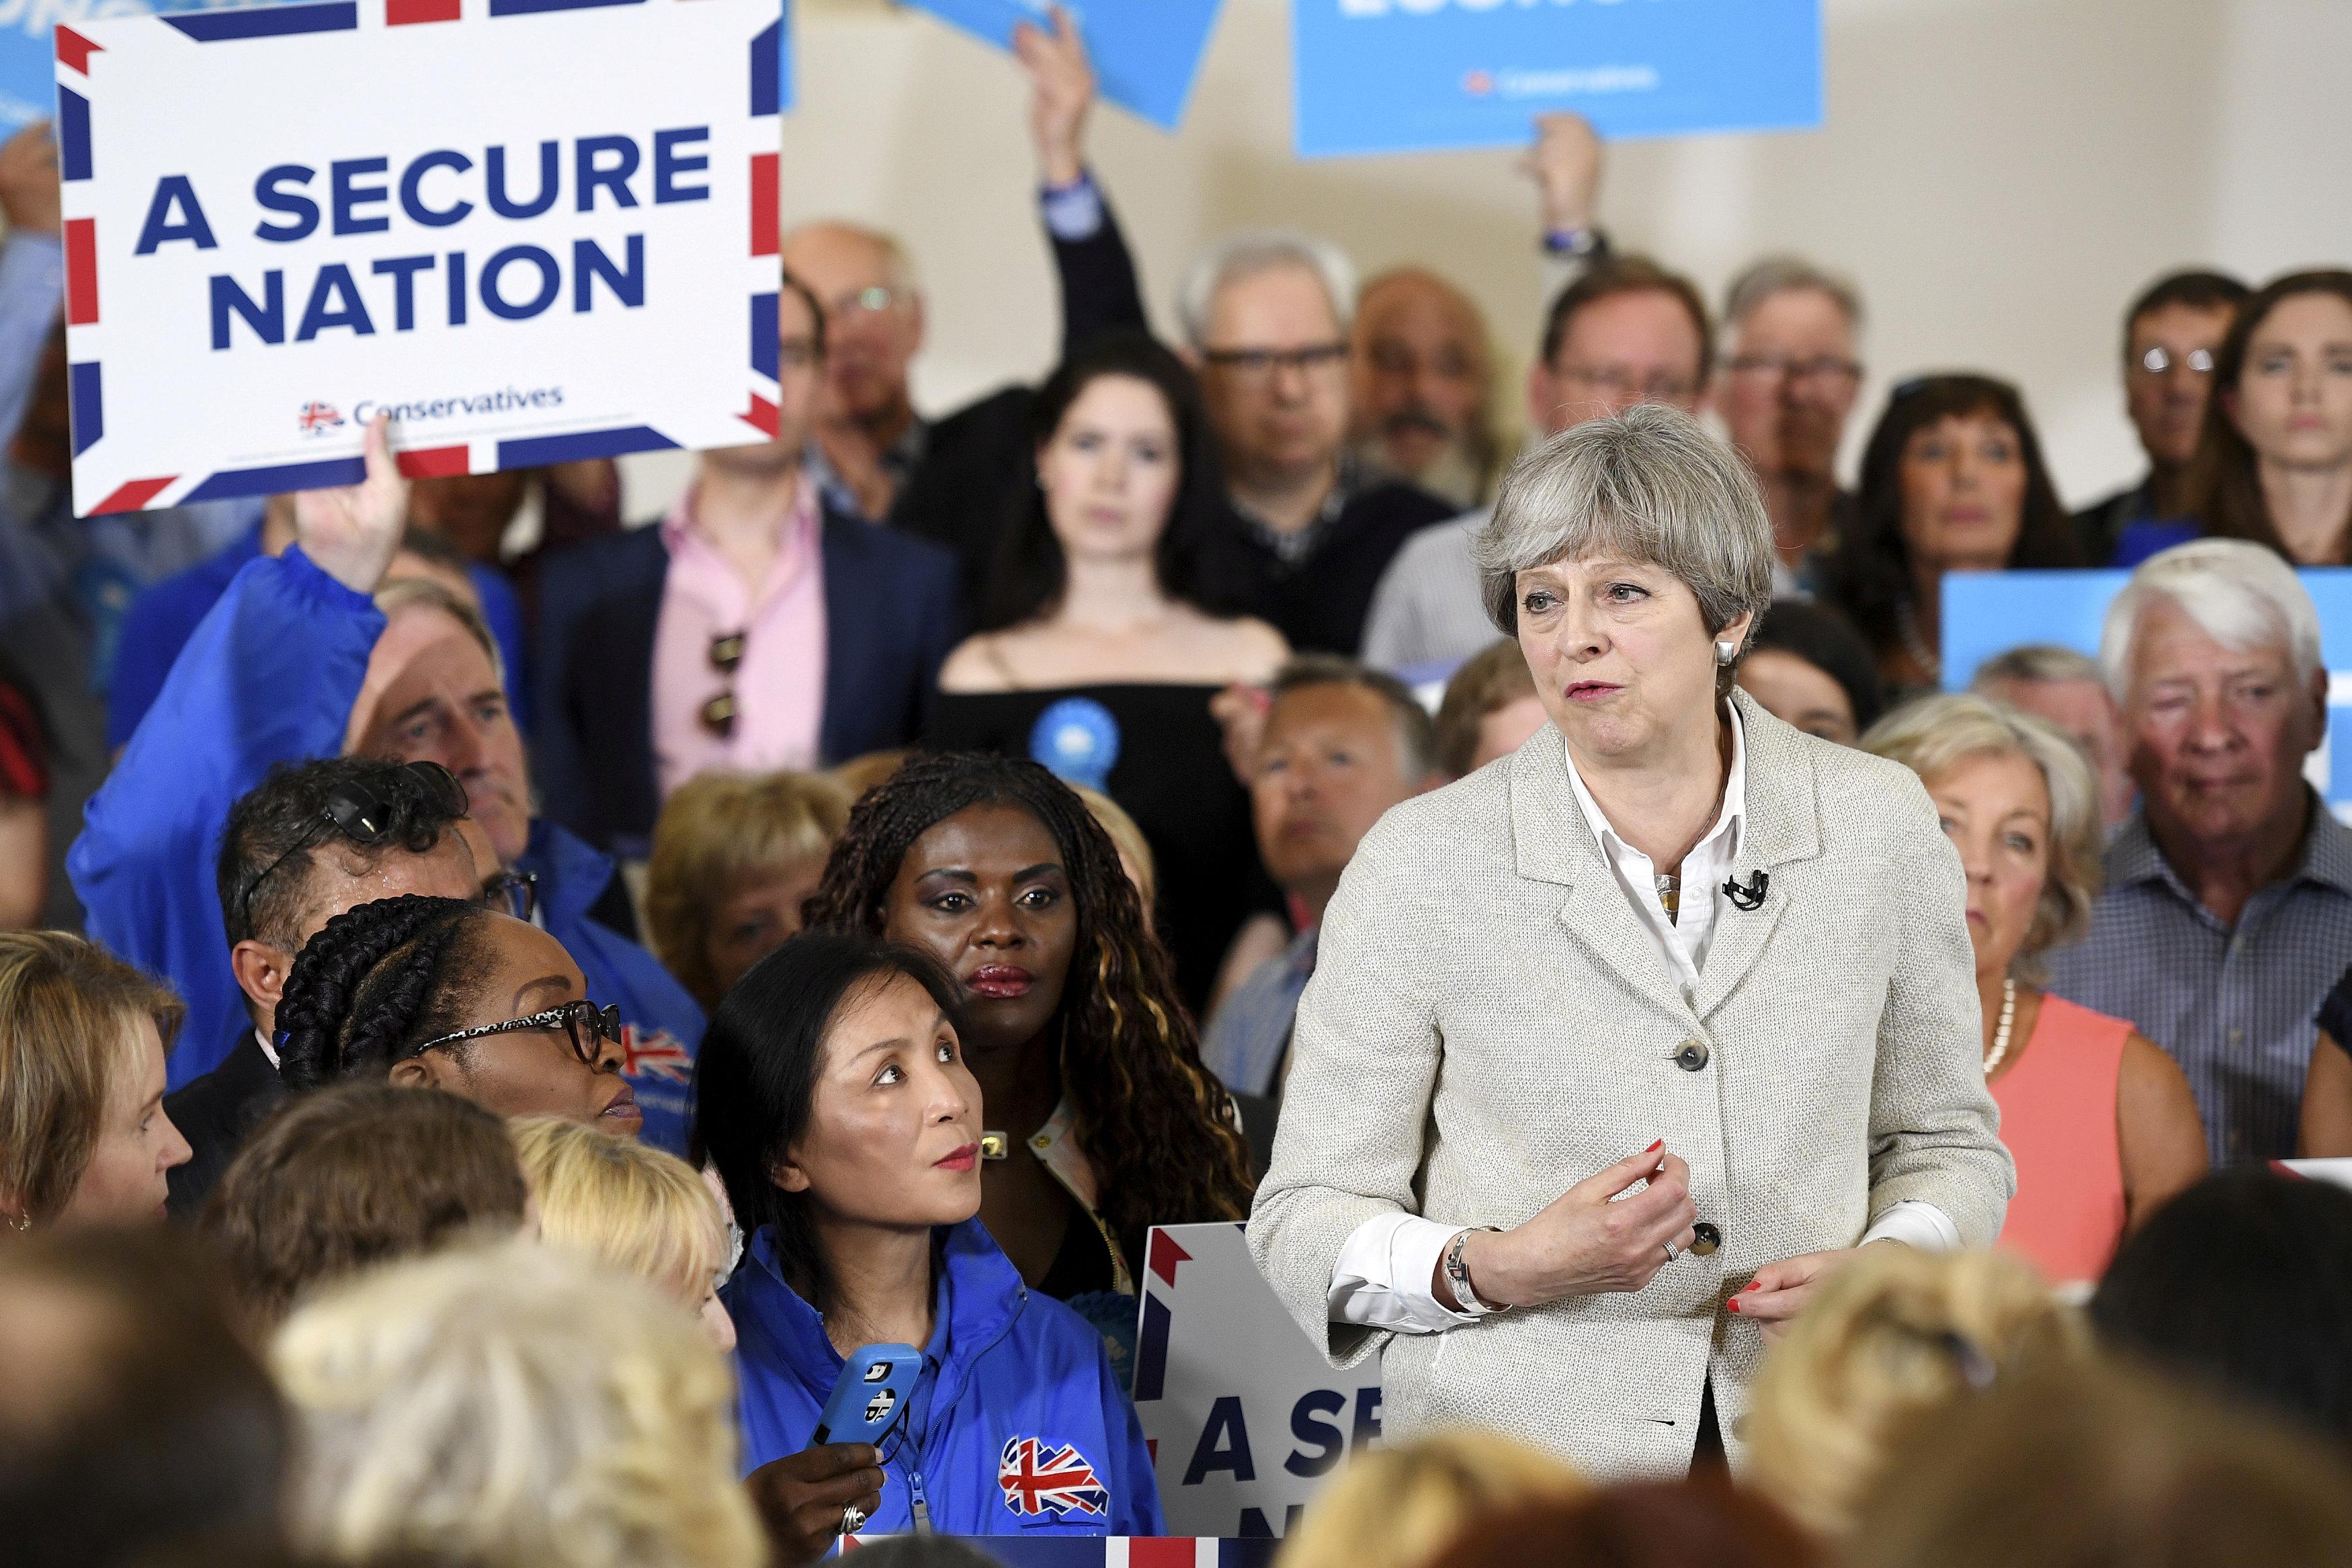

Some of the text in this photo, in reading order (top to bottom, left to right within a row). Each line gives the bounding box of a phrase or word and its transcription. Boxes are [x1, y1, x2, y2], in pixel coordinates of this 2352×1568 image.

[134, 125, 710, 256] A SECURE
[209, 233, 645, 351] NATION
[1181, 1396, 1256, 1486] A
